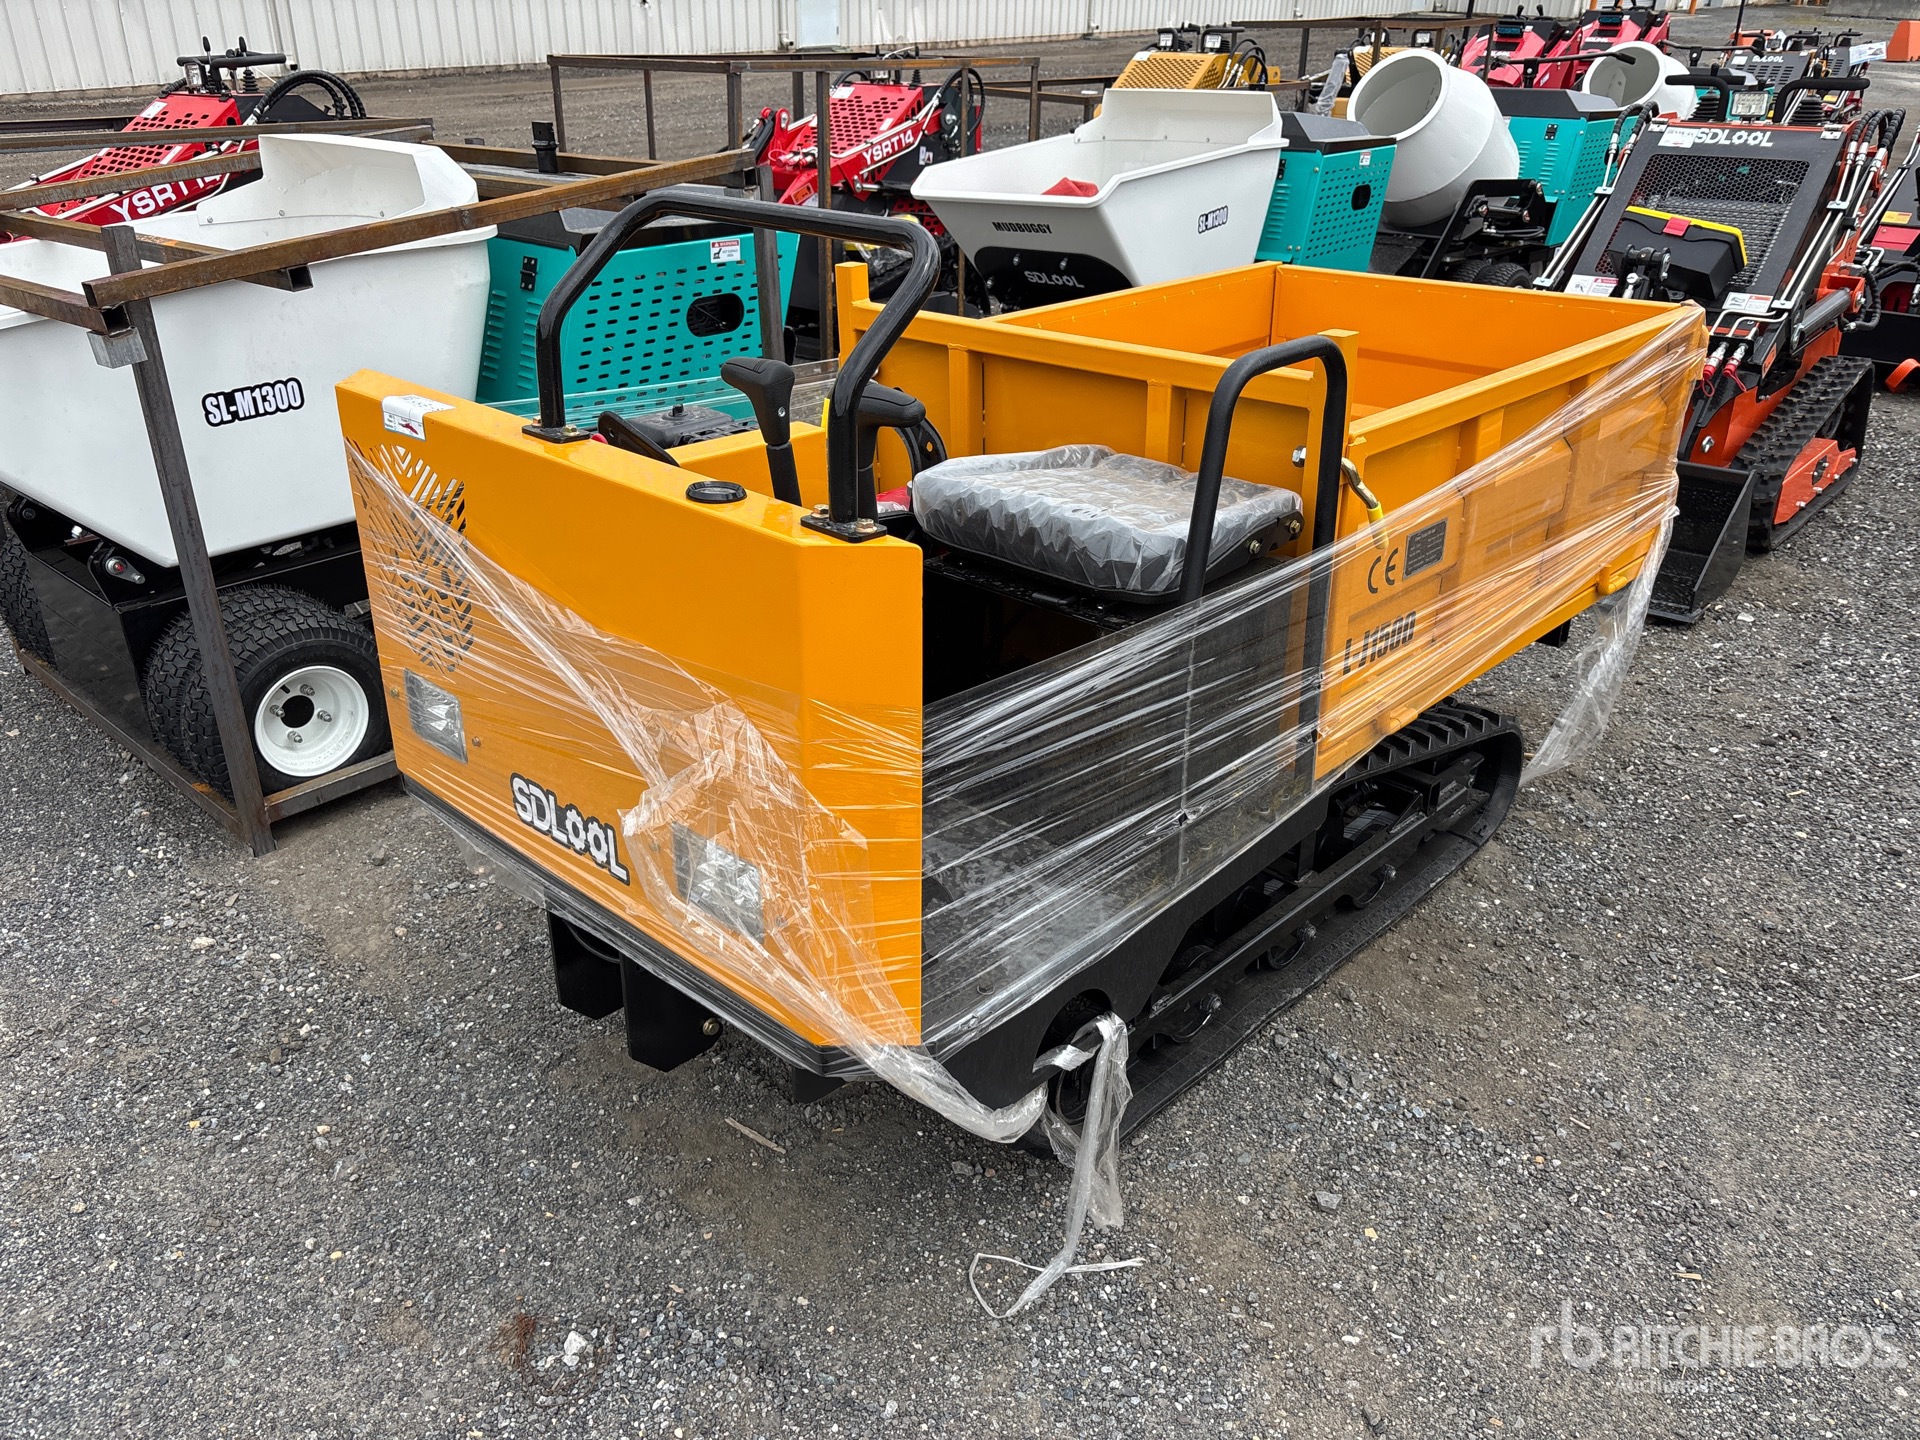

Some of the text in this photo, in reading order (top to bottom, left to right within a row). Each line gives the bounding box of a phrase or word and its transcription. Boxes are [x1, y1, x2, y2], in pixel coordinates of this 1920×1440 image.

[862, 130, 914, 165] YSRT14
[1694, 127, 1774, 147] SDLOOL
[991, 222, 1052, 234] MUDBUGGY
[1024, 270, 1085, 288] SDLOOL
[204, 379, 303, 426] SL-M1300
[1367, 547, 1399, 594] CE
[511, 775, 629, 883] SDLOOL
